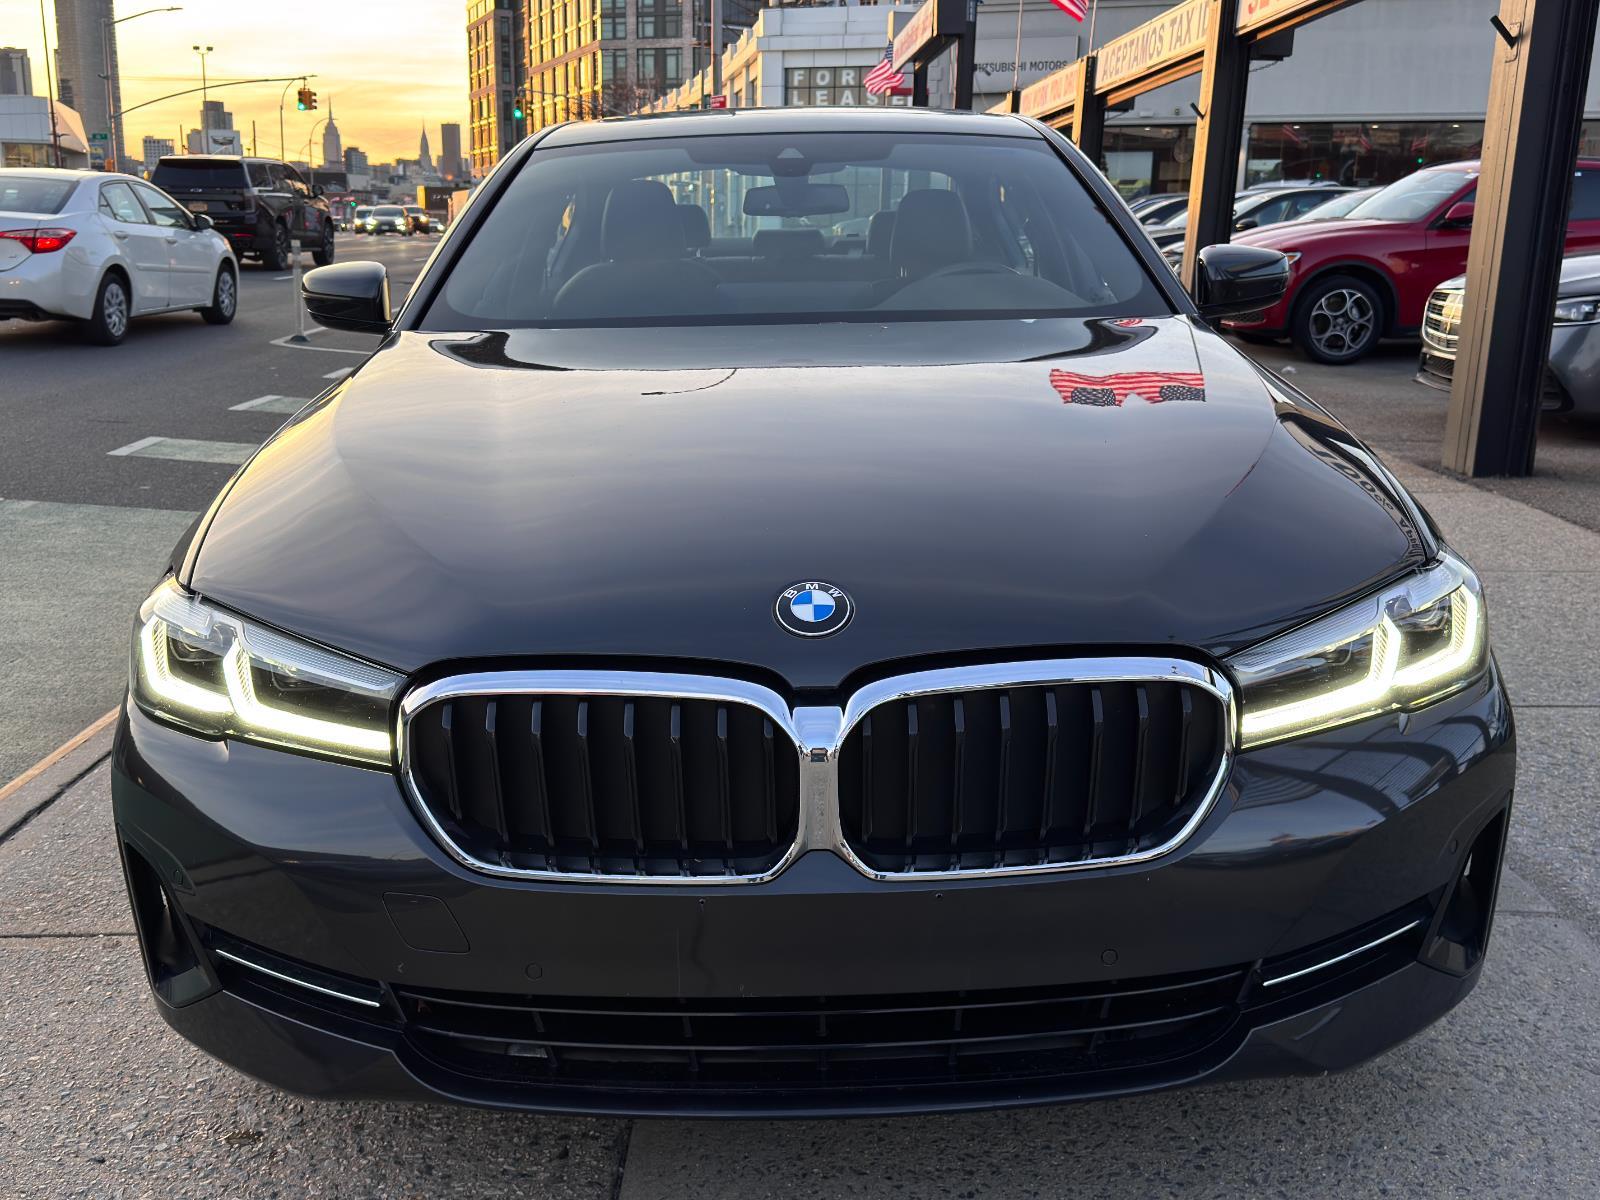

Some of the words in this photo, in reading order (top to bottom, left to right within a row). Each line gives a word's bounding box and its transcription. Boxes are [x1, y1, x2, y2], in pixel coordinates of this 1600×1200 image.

[1102, 23, 1165, 81] ACEPTAMOS
[1168, 7, 1195, 51] TAX
[1031, 61, 1068, 71] MOTORS
[793, 69, 855, 86] FOR
[793, 89, 904, 106] LEASE
[783, 583, 843, 599] BMW
